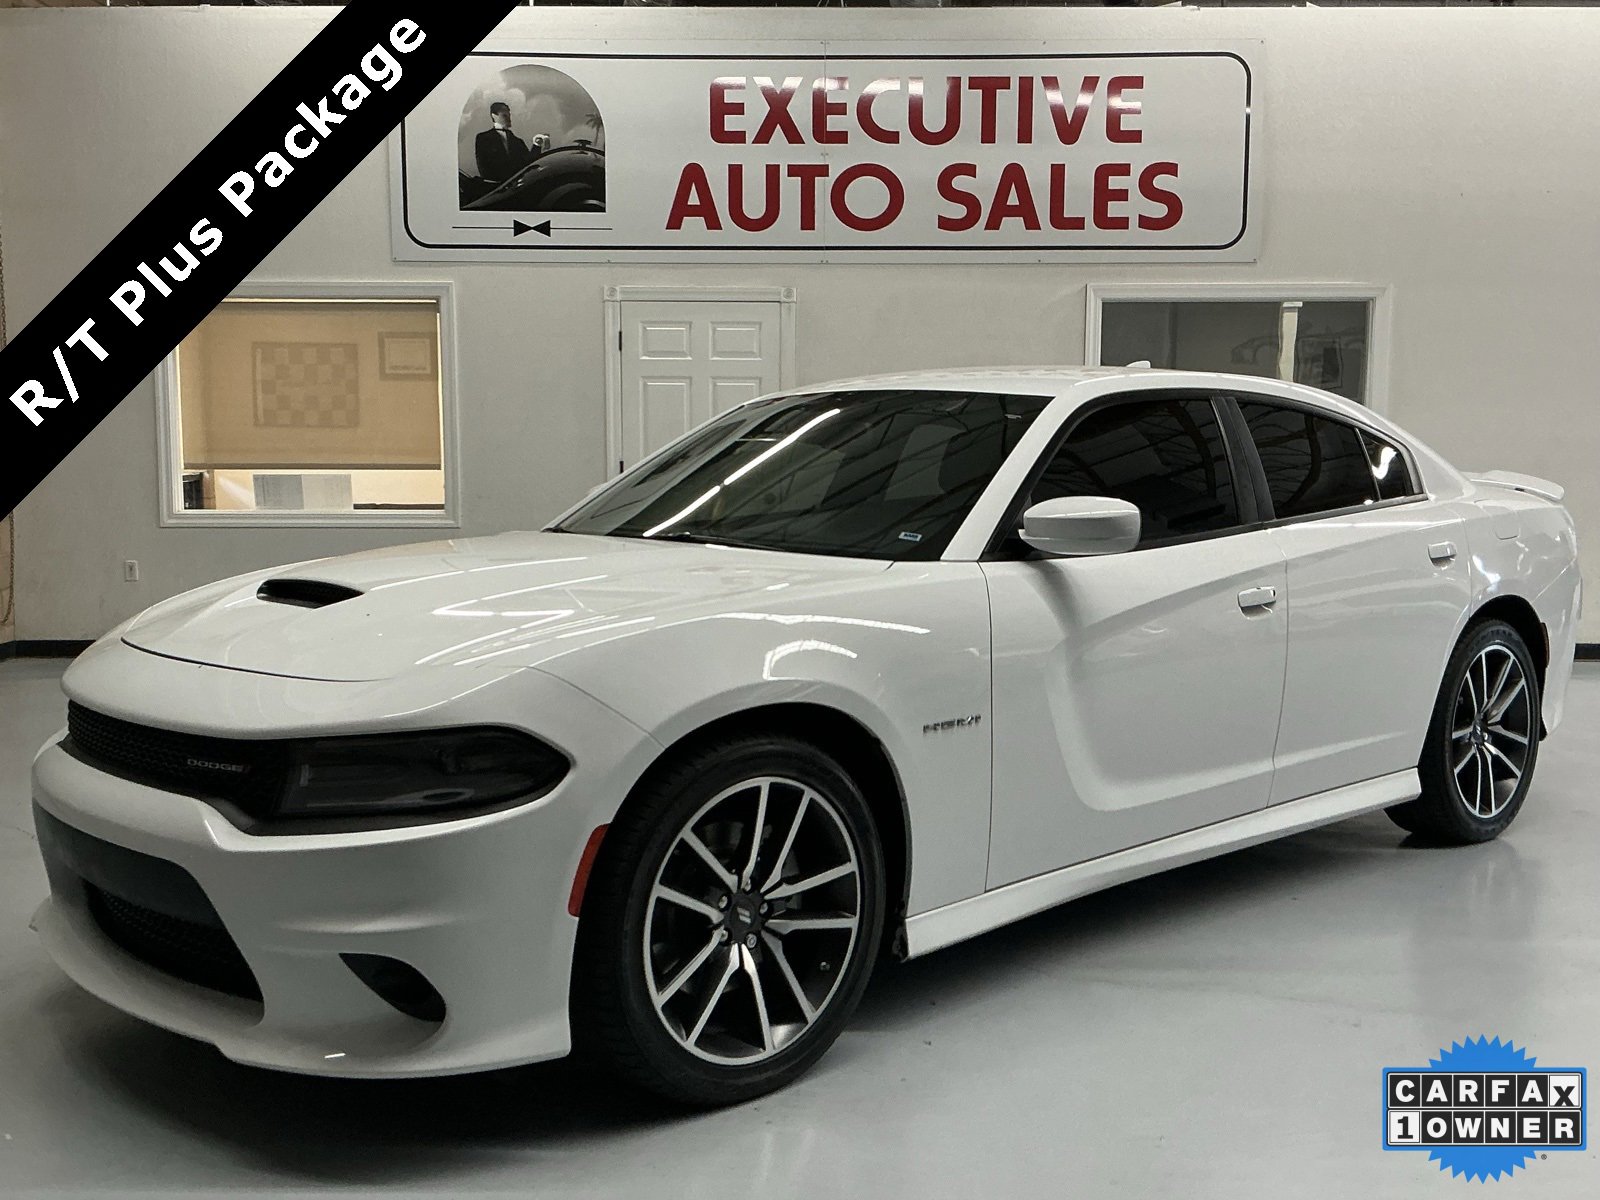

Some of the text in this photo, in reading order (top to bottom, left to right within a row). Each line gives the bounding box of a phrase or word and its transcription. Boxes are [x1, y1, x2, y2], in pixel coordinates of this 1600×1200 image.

[709, 75, 1144, 145] EXECUTIVE
[666, 161, 1184, 232] AUTO SALES
[187, 758, 243, 772] DODGE
